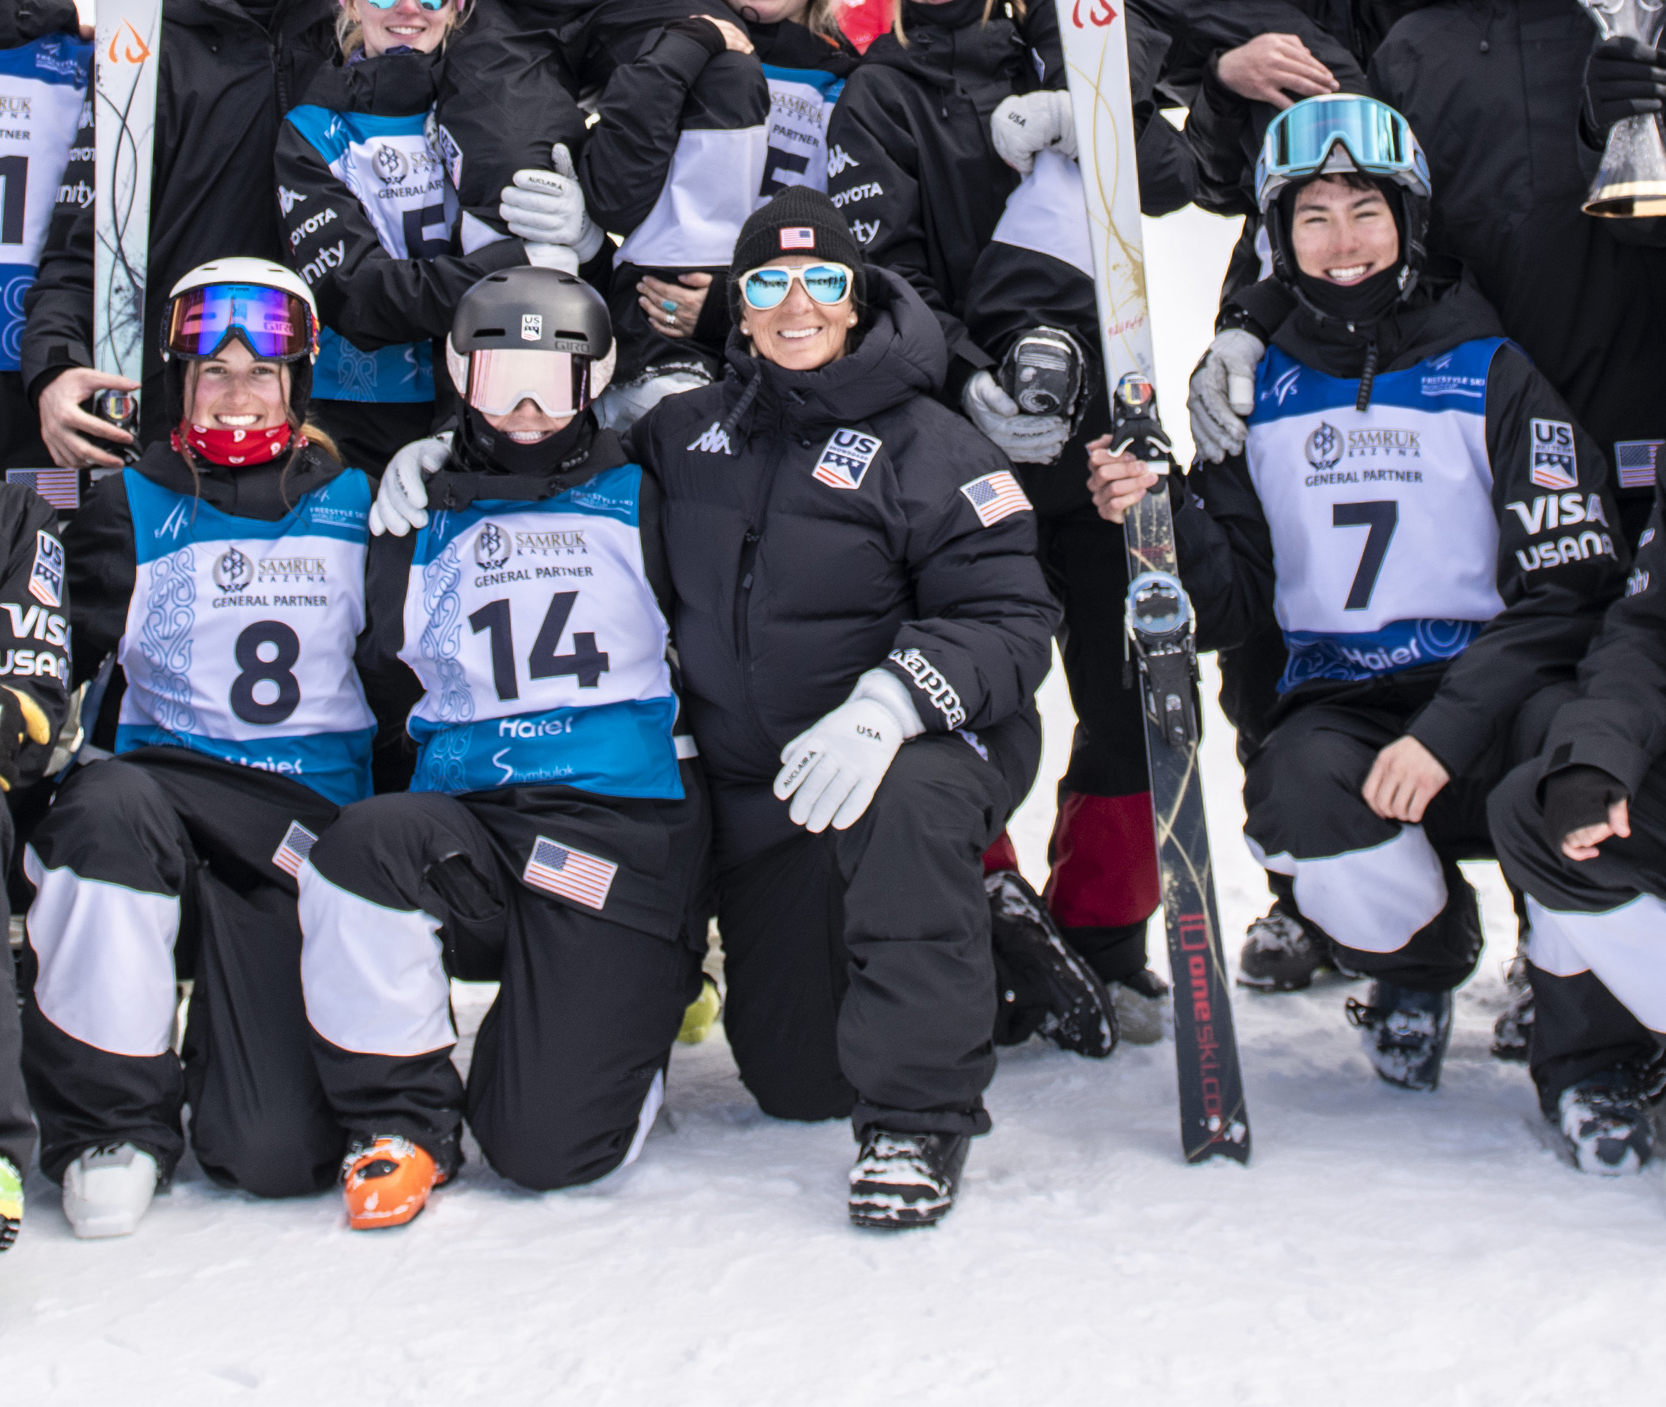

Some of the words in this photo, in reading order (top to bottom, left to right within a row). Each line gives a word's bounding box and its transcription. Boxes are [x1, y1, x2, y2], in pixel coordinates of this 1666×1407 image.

[1008, 111, 1027, 128] USA
[772, 124, 820, 148] PARTNER
[290, 207, 339, 246] OYOTA
[524, 316, 540, 324] US
[555, 340, 591, 353] GIRO
[834, 431, 877, 455] US
[1347, 430, 1421, 447] SAMRUK
[1535, 423, 1571, 445] US
[1348, 448, 1421, 458] KAZYNA
[1305, 471, 1360, 487] GENERAL
[1362, 469, 1423, 483] PARTNER
[1505, 493, 1610, 535] VISA
[515, 531, 587, 547] SAMRUK
[40, 535, 62, 567] US
[1332, 499, 1400, 612] 7
[1515, 530, 1619, 572] USANA
[258, 559, 327, 574] SAMRUK
[475, 569, 532, 588] GENERAL
[535, 566, 594, 579] PARTNER
[258, 575, 326, 583] KAZYNA
[212, 596, 269, 609] GENERAL
[273, 595, 328, 607] PARTNER
[468, 590, 610, 702] 14
[1342, 637, 1422, 671] Haier
[229, 619, 301, 726] 8
[498, 716, 574, 738] Haier
[856, 724, 883, 743] USA
[783, 756, 810, 788] AUCLAIR
